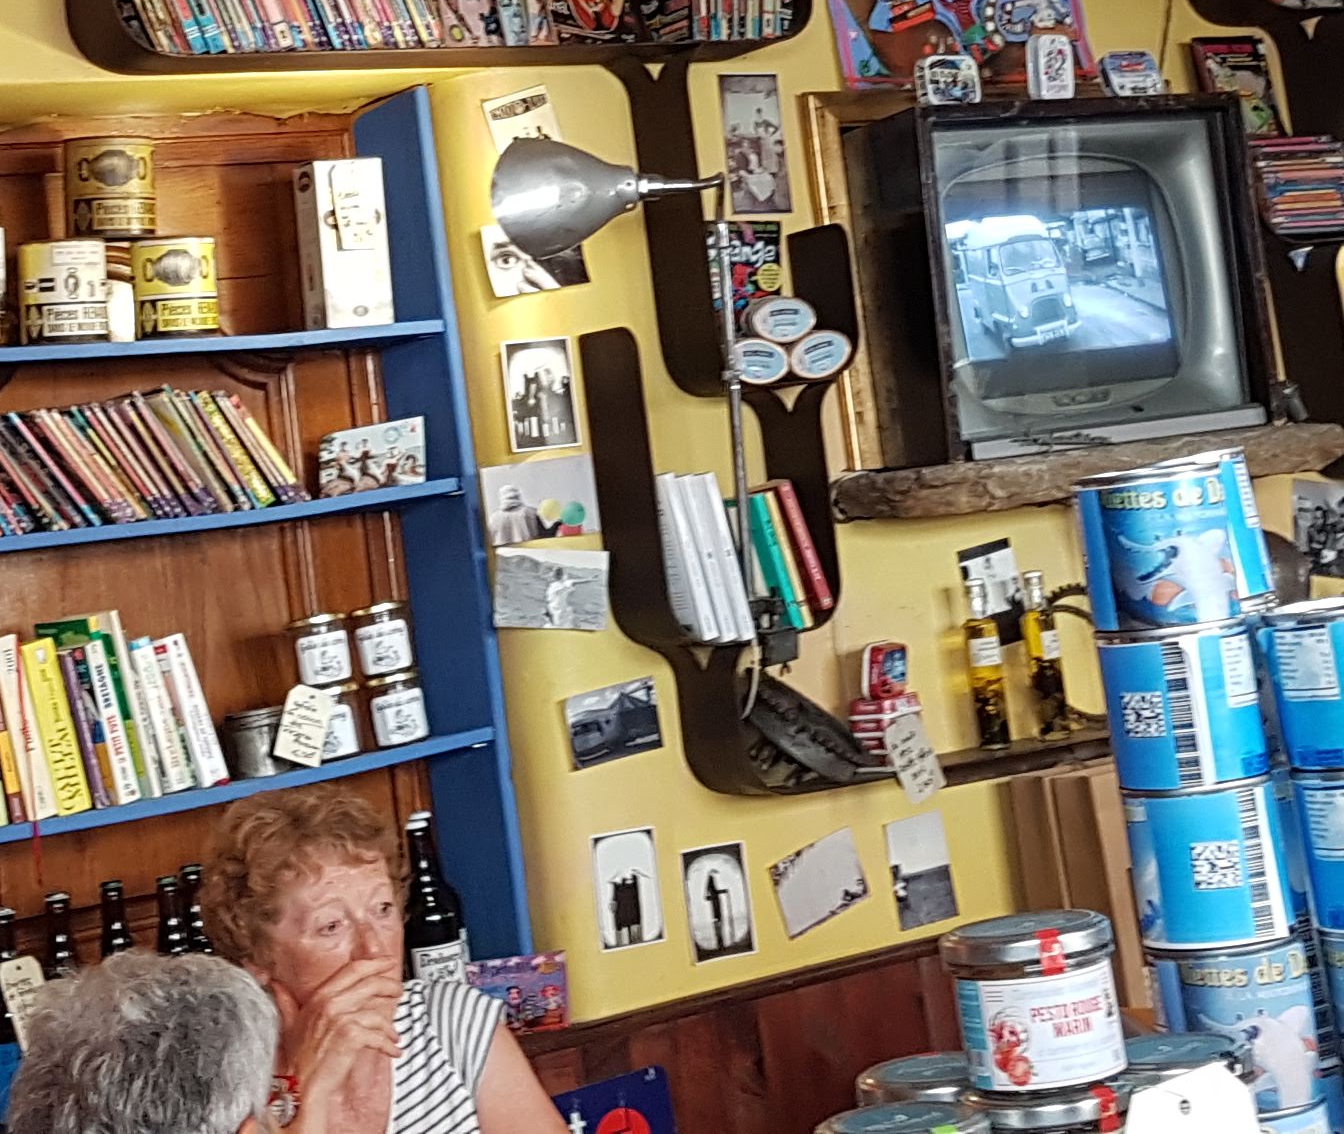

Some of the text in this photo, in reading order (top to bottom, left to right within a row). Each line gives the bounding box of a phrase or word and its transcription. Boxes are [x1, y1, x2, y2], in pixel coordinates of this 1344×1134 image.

[1172, 486, 1204, 509] de
[94, 663, 113, 709] BRETAGNE
[1253, 955, 1285, 985] de
